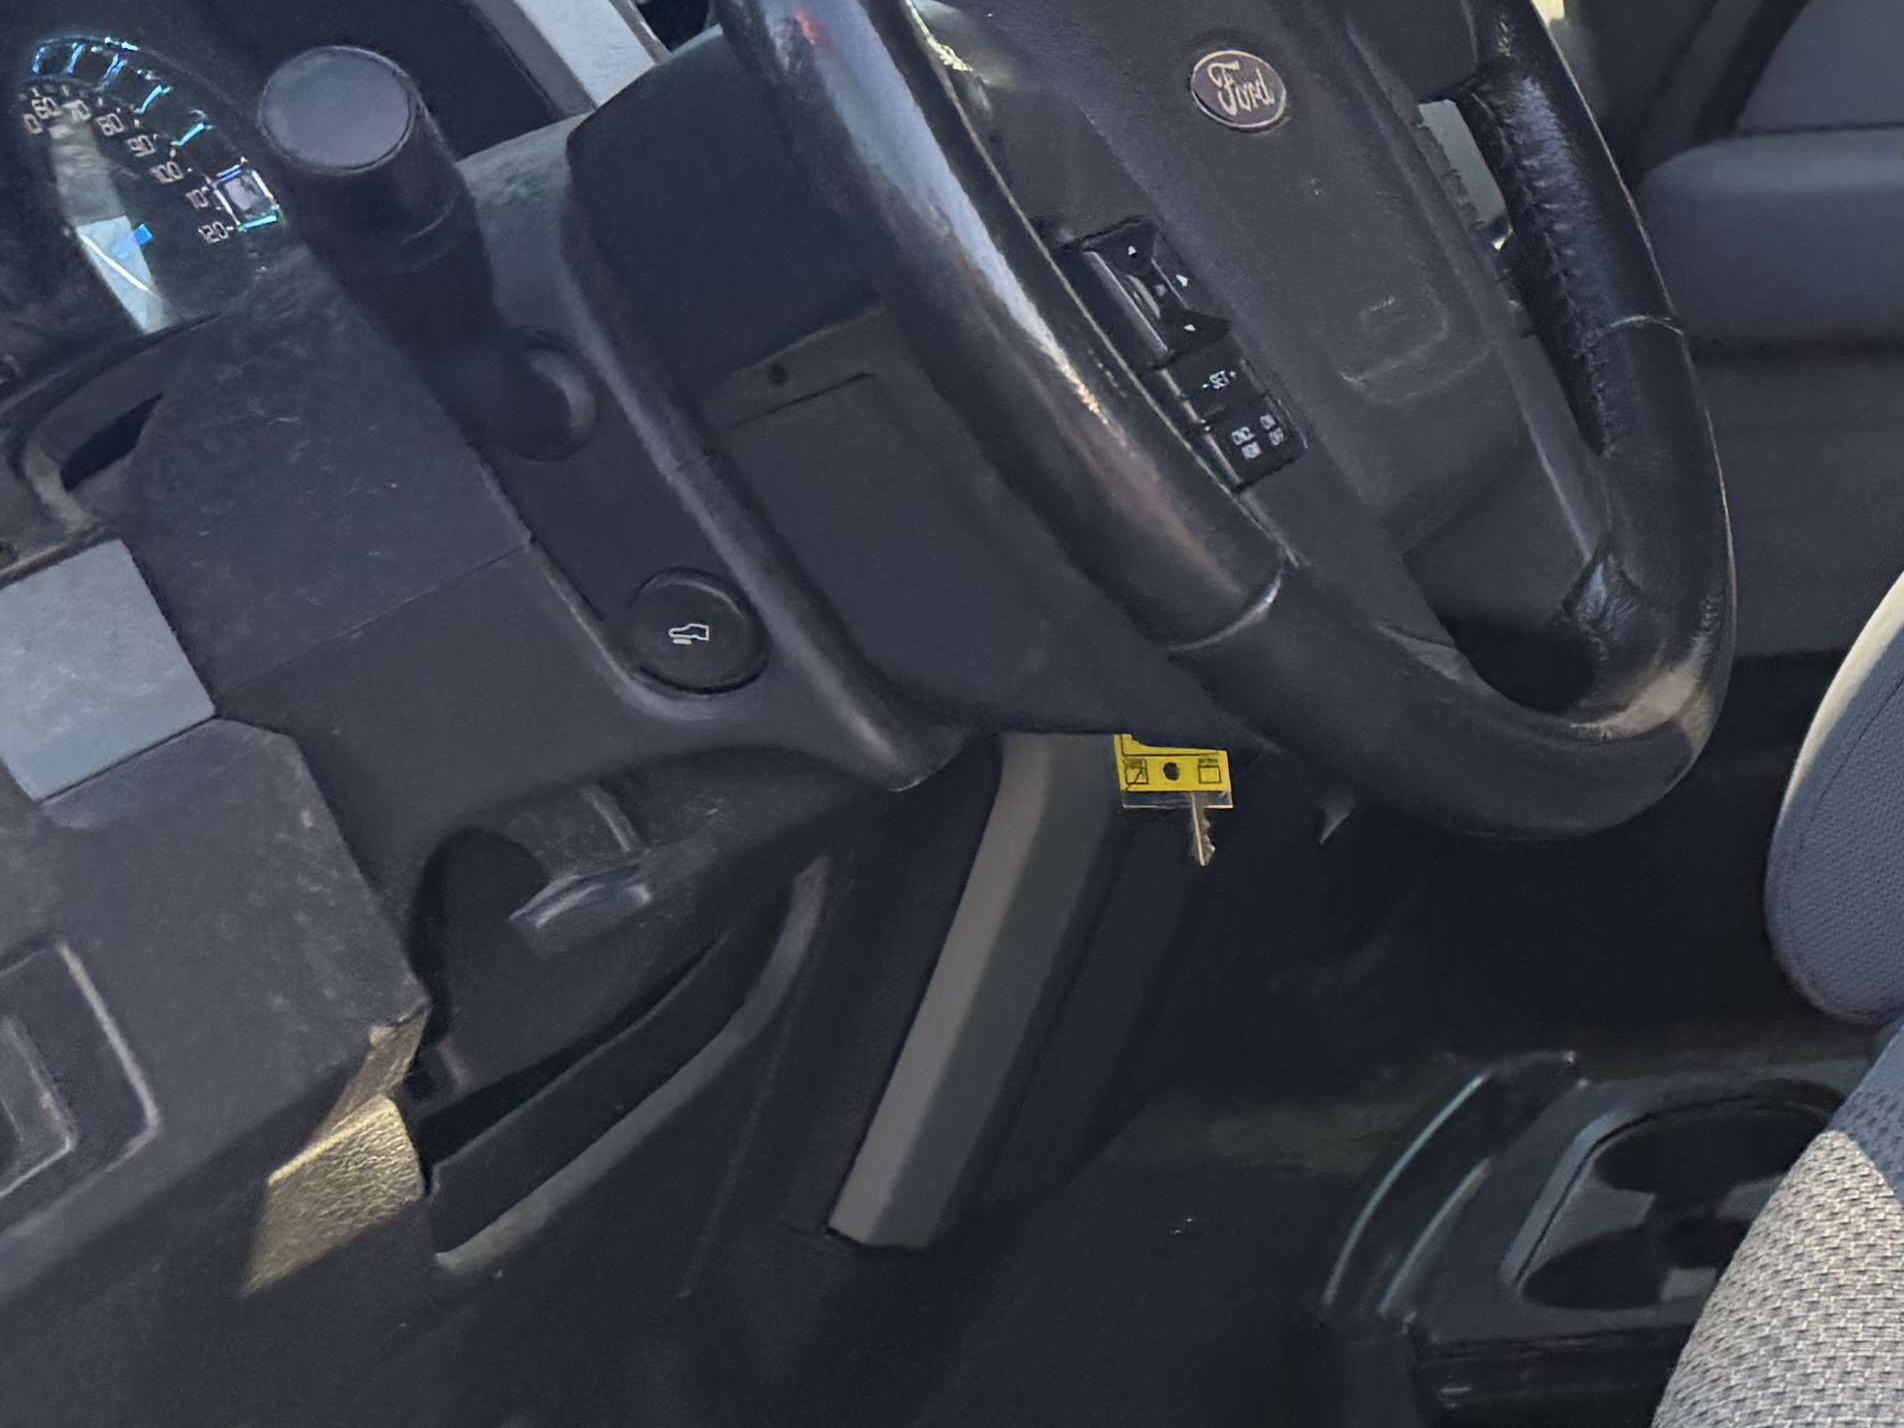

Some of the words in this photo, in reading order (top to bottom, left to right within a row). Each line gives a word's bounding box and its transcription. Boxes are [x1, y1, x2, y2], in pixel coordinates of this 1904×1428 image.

[1207, 60, 1275, 116] Ford
[31, 97, 62, 120] 60
[62, 99, 92, 122] 70
[95, 113, 125, 136] 80
[126, 135, 156, 157] 90
[150, 161, 184, 184] 100
[197, 221, 229, 243] 120
